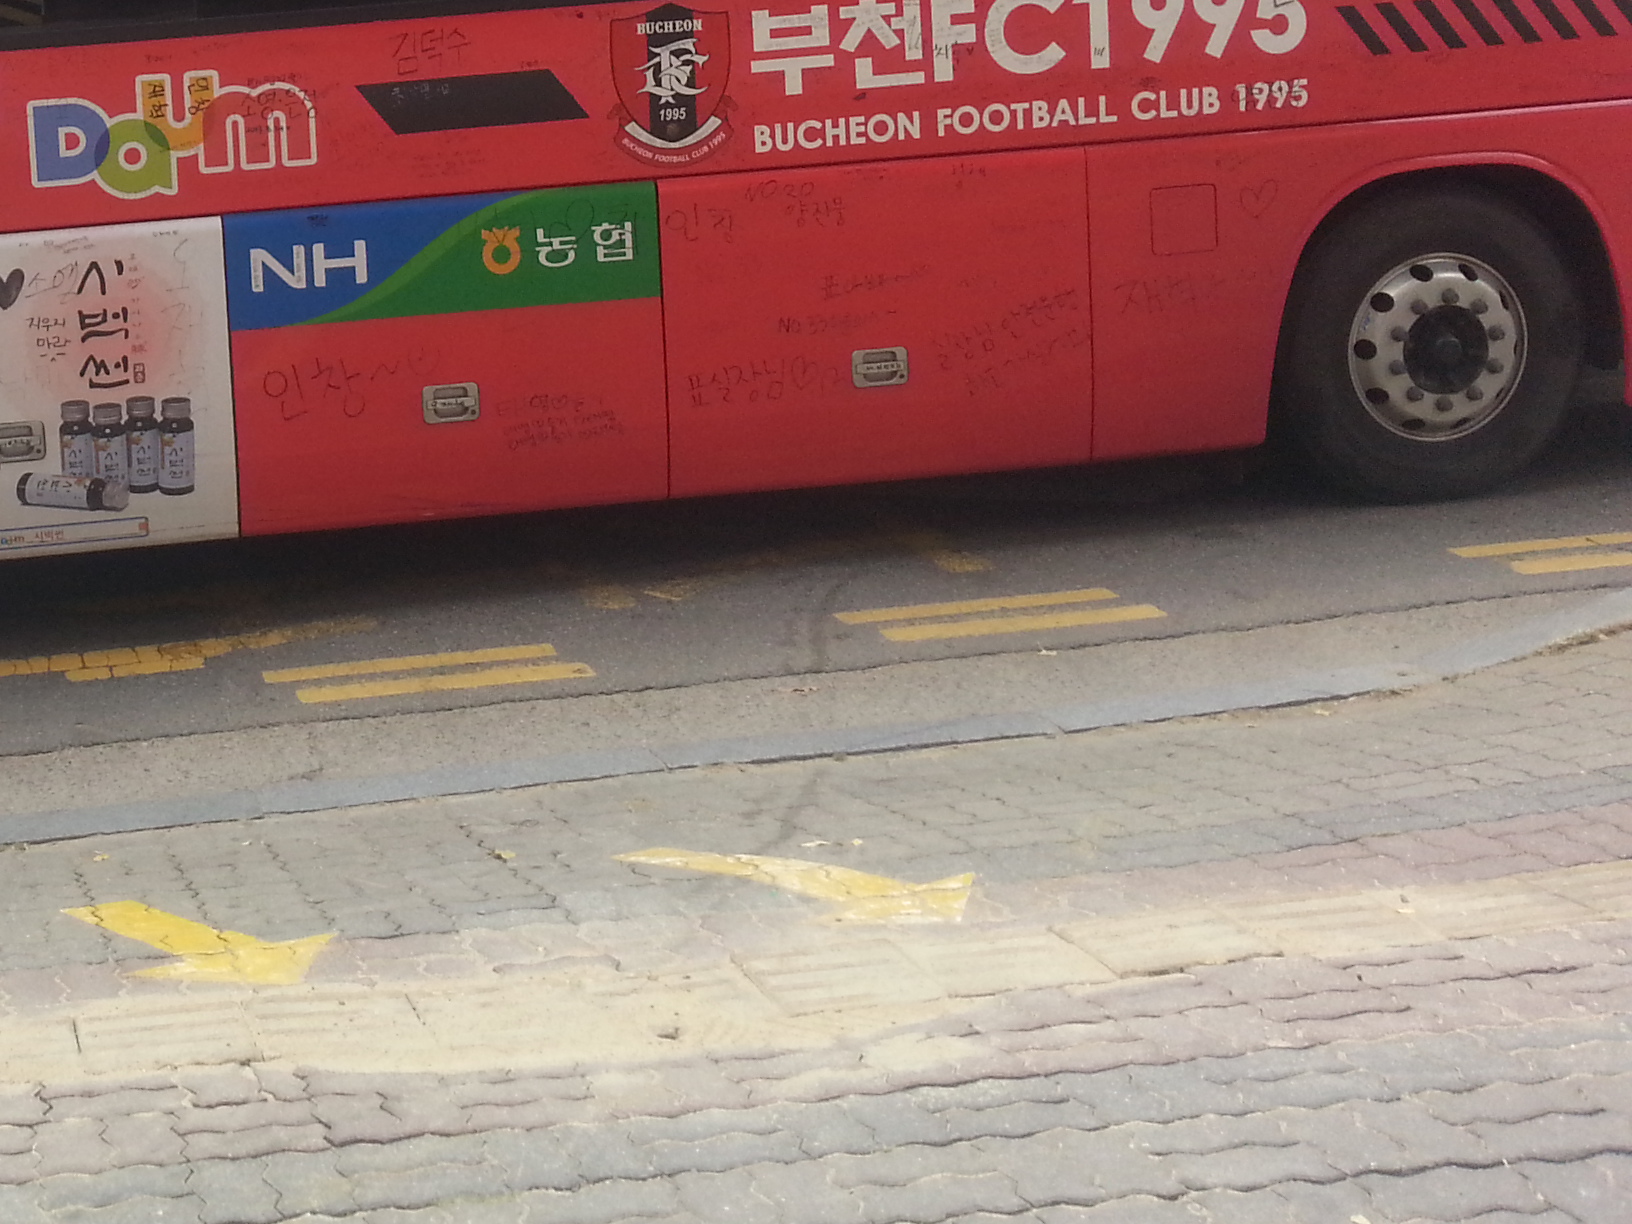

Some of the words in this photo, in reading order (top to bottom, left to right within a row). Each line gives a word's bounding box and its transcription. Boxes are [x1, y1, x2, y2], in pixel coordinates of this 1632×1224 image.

[636, 19, 703, 35] BUCHEON
[658, 107, 687, 122] 1995
[754, 114, 921, 154] BUCHEON
[937, 97, 1117, 137] FOOTBALL
[1130, 87, 1220, 120] CLUB
[1236, 79, 1309, 113] 1995
[249, 239, 368, 292] NH
[535, 221, 634, 268] 농협
